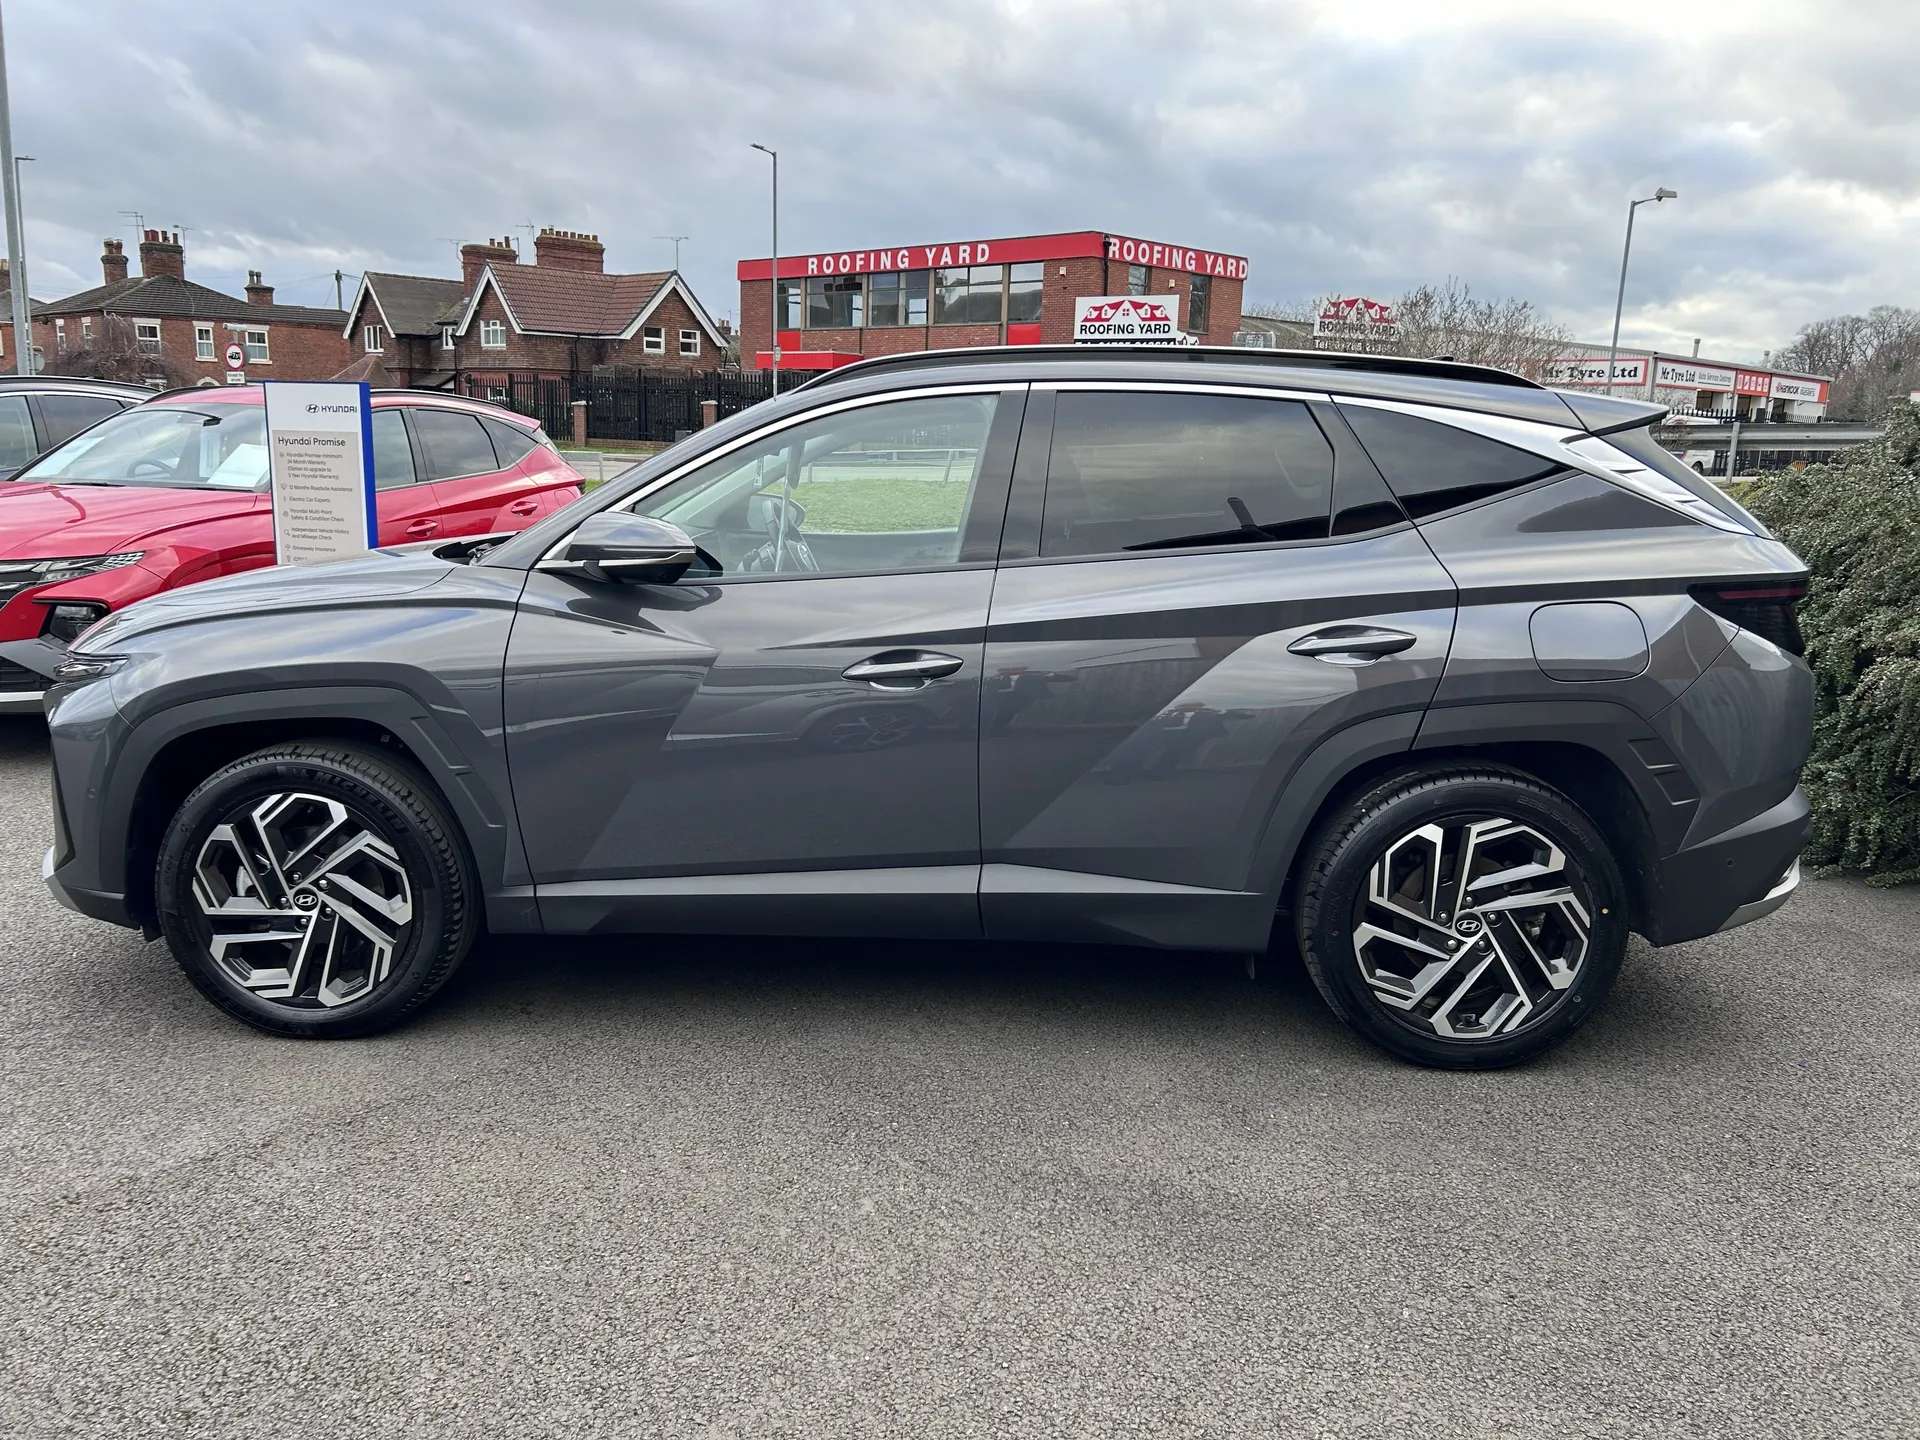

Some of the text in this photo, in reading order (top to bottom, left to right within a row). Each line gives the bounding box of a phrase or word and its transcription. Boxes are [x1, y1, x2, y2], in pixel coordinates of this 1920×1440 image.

[807, 243, 990, 275] ROOFING YARD
[1108, 237, 1248, 279] ROOFING YARD
[1080, 323, 1171, 335] ROOFING YARD
[1567, 366, 1604, 380] Tyre
[1612, 366, 1638, 378] Ltd
[1661, 366, 1696, 383] Mr Tyre Ltd
[321, 405, 358, 413] HYUNDAI
[278, 436, 346, 447] Hyundai Promise
